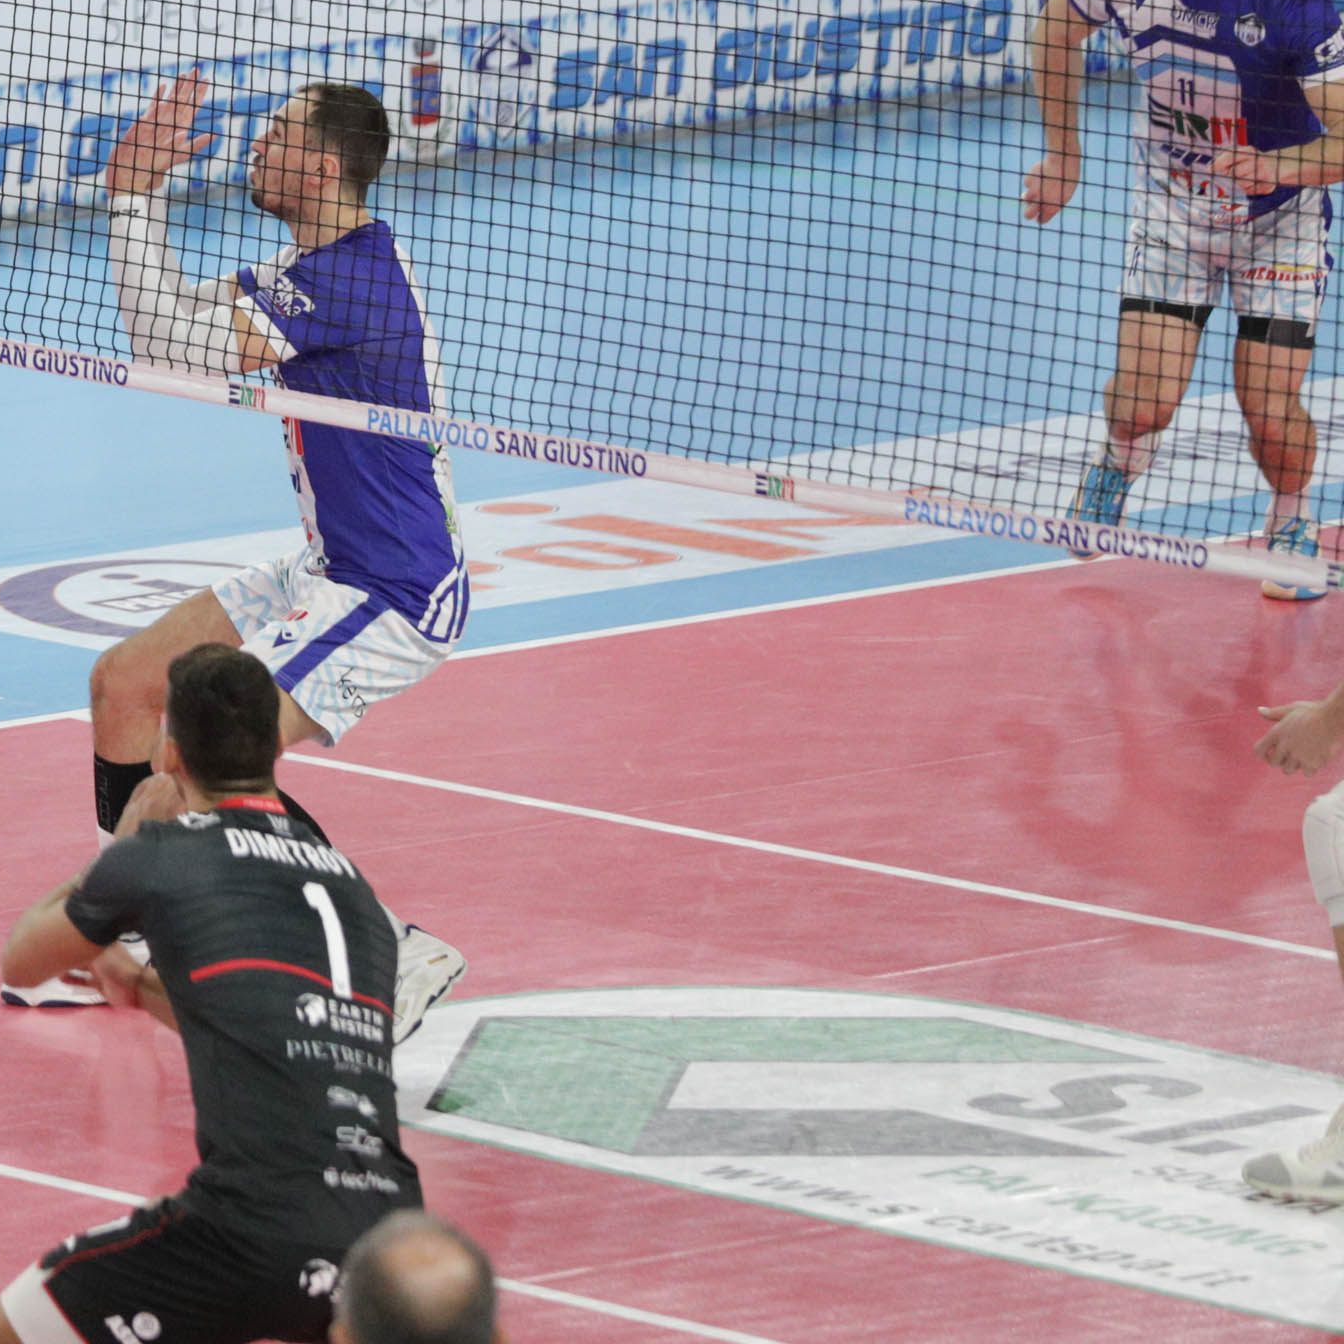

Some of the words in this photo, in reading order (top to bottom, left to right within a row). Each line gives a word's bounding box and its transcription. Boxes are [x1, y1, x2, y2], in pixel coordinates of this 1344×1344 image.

[32, 347, 129, 388] GIUSTINO
[367, 408, 490, 452] PALLAVOLO
[494, 429, 540, 459] SAN
[544, 438, 647, 479] GIUSTINO
[904, 496, 1038, 544] PALLAVOLO
[1042, 519, 1090, 550] SAN
[1096, 528, 1210, 570] GIUSTINO
[224, 827, 357, 879] DIMITROV
[302, 881, 353, 1000] 1
[328, 998, 384, 1026] EARTH
[329, 1015, 384, 1043] SYSTEM
